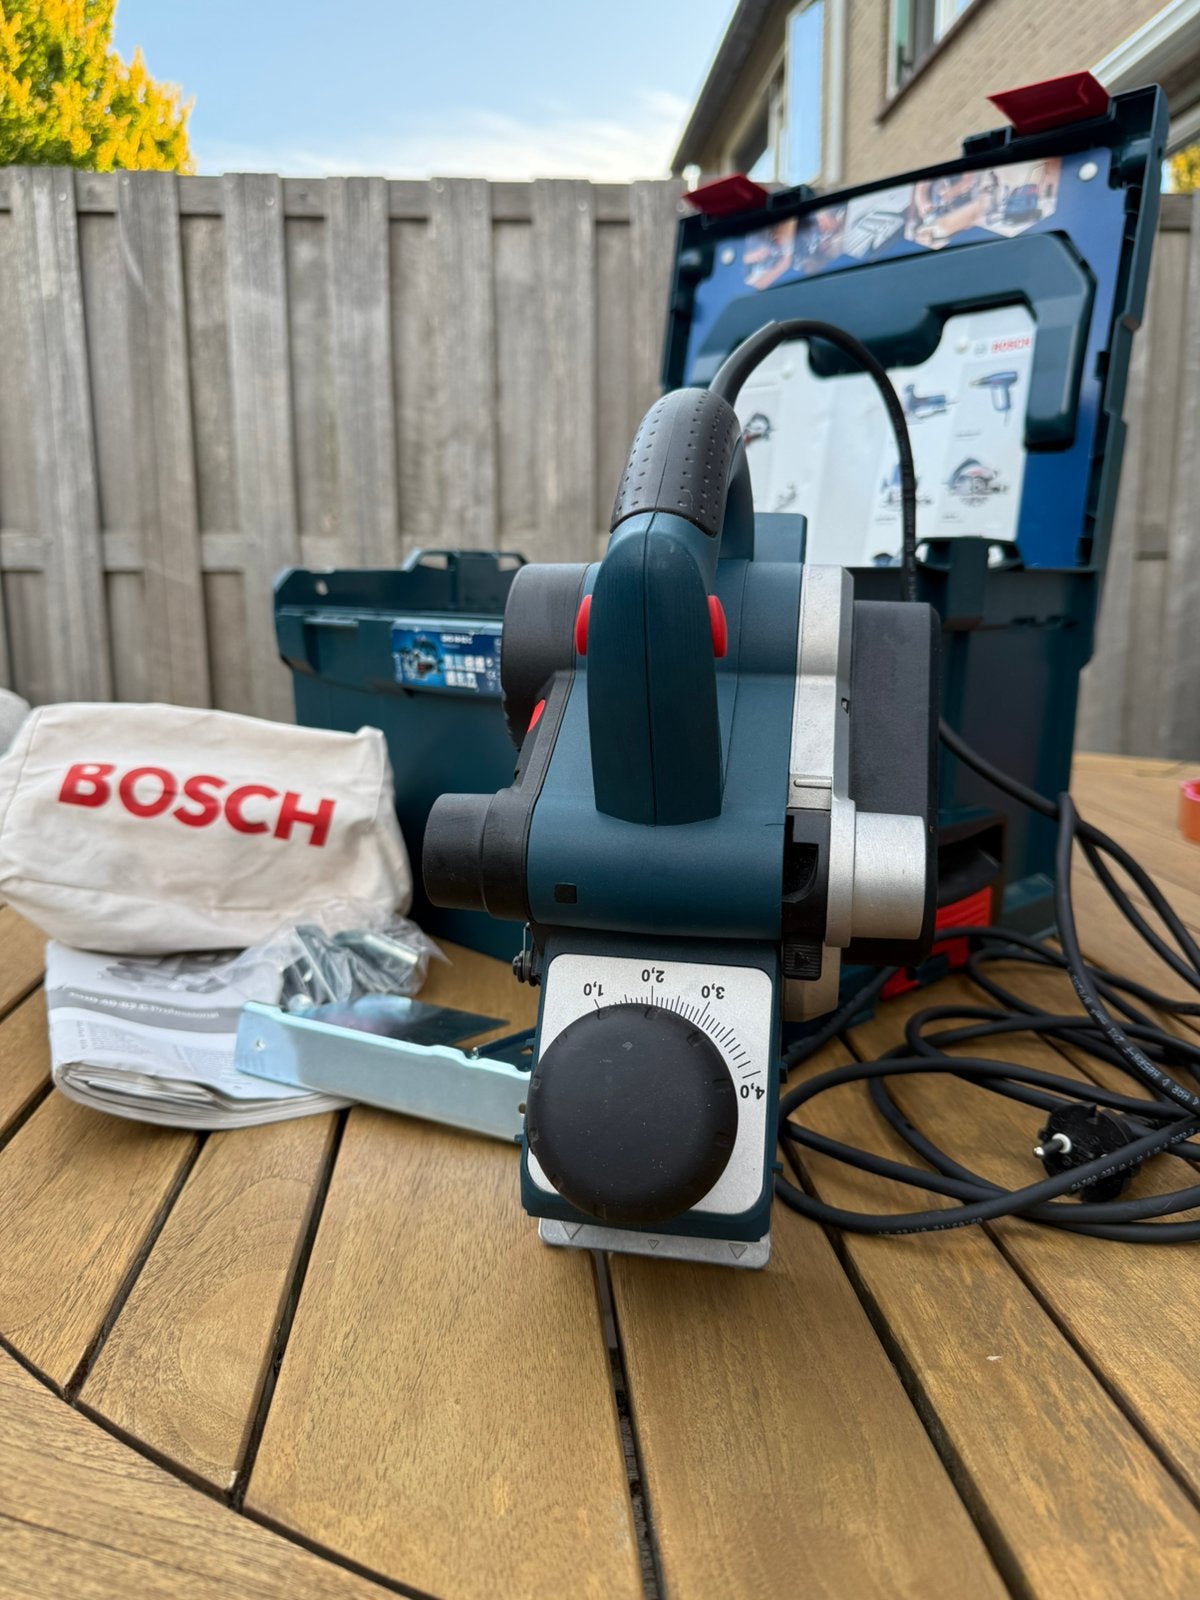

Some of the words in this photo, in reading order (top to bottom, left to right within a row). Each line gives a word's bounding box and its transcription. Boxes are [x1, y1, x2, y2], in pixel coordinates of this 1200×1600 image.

[58, 763, 336, 847] BOSCH
[641, 967, 665, 983] 2,0
[583, 981, 604, 997] 1,0
[701, 983, 725, 1000] 3,0
[740, 1083, 765, 1100] 4,0
[1171, 1084, 1190, 1101] HAR
